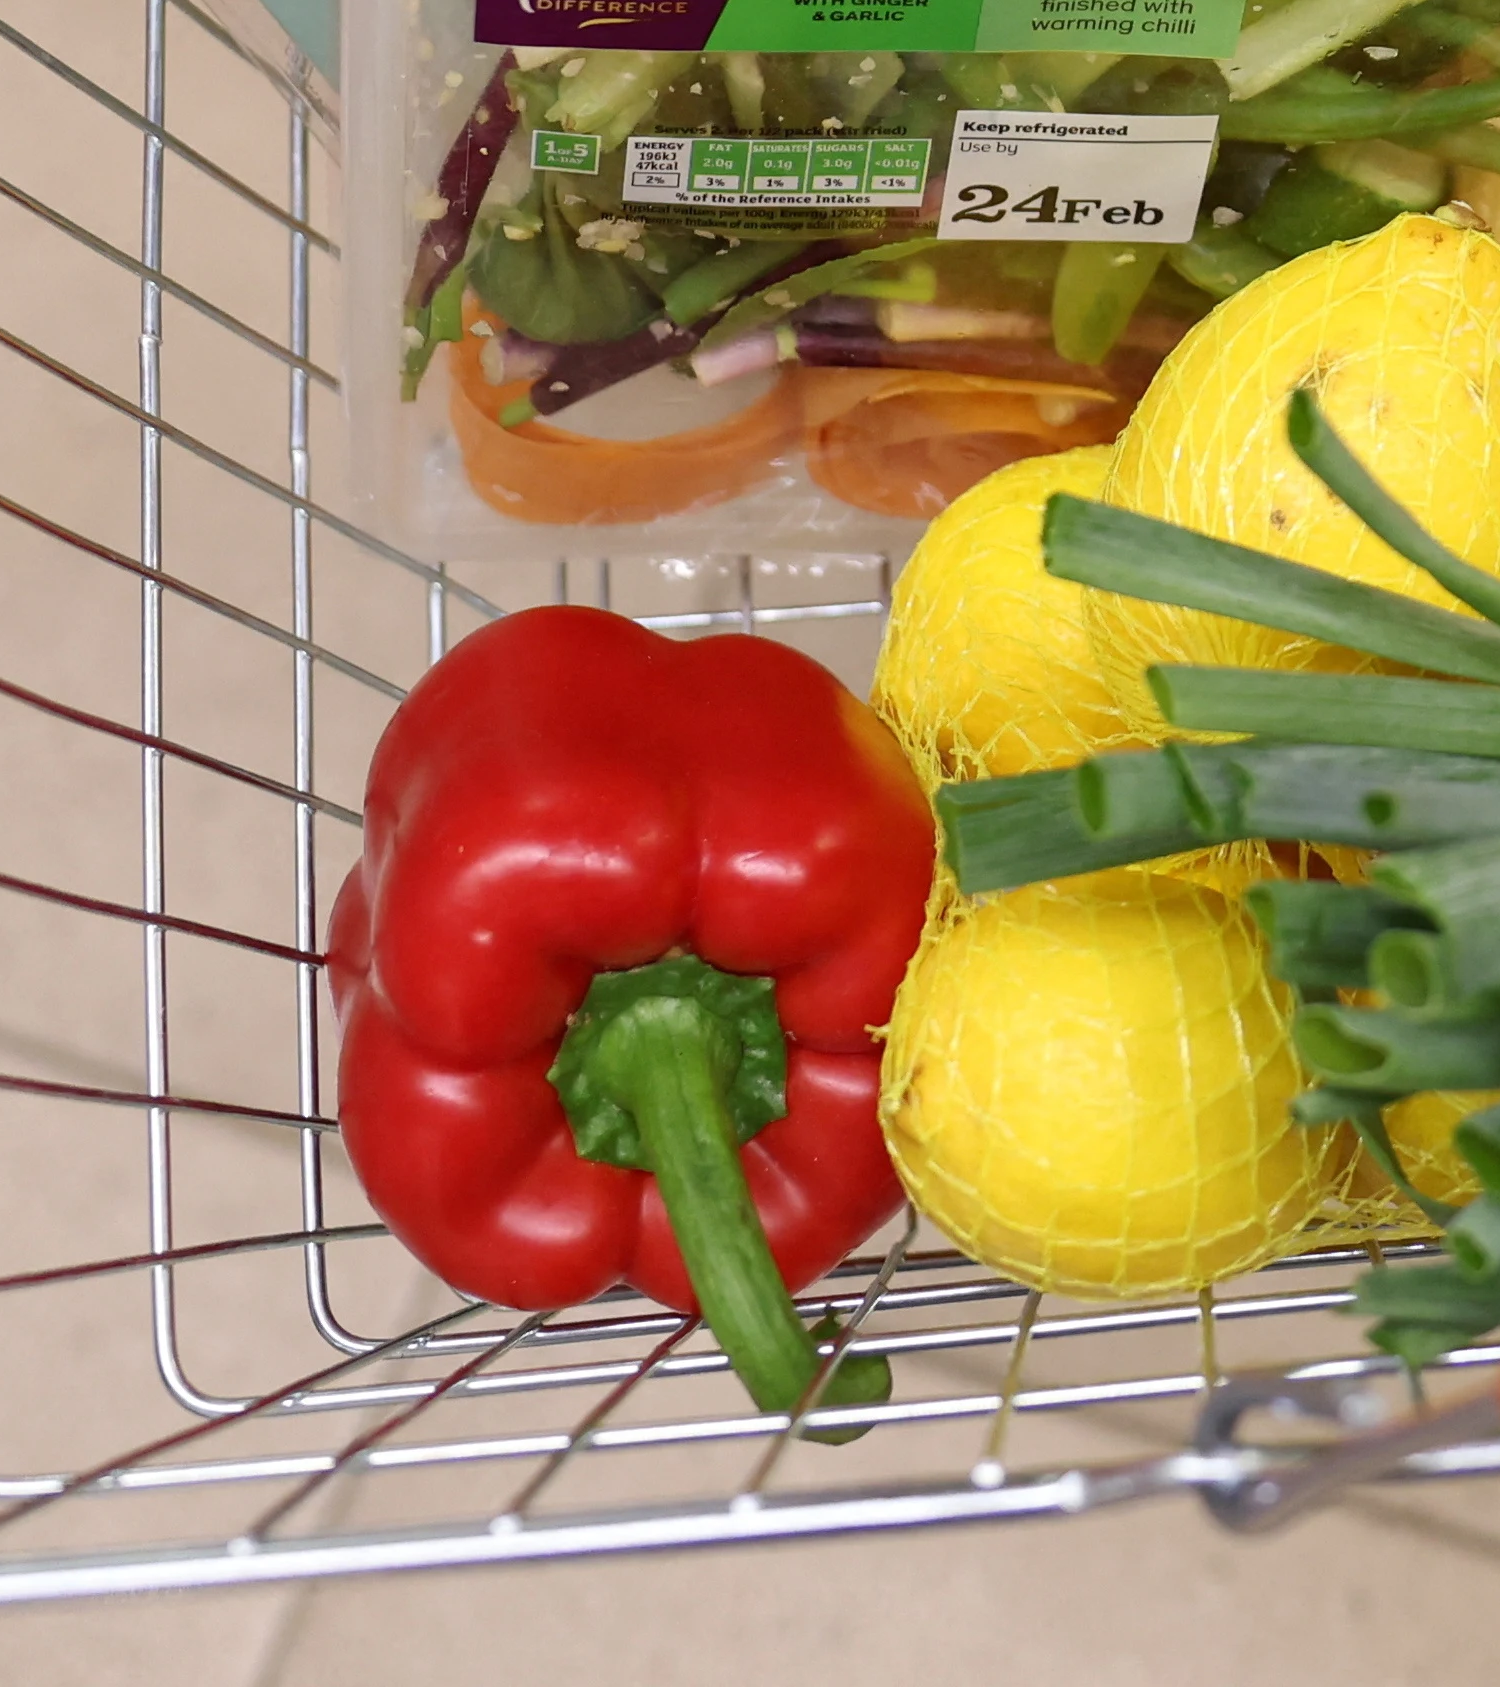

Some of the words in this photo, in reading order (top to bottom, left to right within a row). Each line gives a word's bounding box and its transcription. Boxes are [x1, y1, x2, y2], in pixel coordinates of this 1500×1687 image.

[1144, 0, 1193, 14] with
[812, 11, 826, 21] &
[830, 11, 905, 21] GARLIC
[1032, 16, 1134, 34] warming
[1142, 18, 1196, 34] chilli
[963, 121, 1010, 134] Keep
[1015, 122, 1128, 137] refrigerated
[634, 142, 685, 150] ENERGY
[708, 143, 733, 152] FAT
[752, 144, 809, 153] SATURATES
[815, 144, 864, 153] SUGARS
[884, 143, 915, 152] SALT
[960, 142, 991, 153] Use
[996, 141, 1018, 155] by
[639, 152, 677, 161] 196kJ
[635, 161, 678, 171] 47kcal
[702, 158, 734, 169] 2.0g
[764, 159, 793, 170] 0.1g
[823, 159, 853, 169] 3.0g
[645, 176, 665, 184] 2%
[705, 177, 725, 187] 3%
[766, 179, 784, 187] 1%
[824, 178, 843, 187] 3%
[881, 178, 906, 187] <1%
[675, 192, 689, 202] %
[692, 193, 708, 203] of
[711, 194, 735, 204] the
[739, 194, 812, 204] Reference
[815, 195, 871, 204] Intakes
